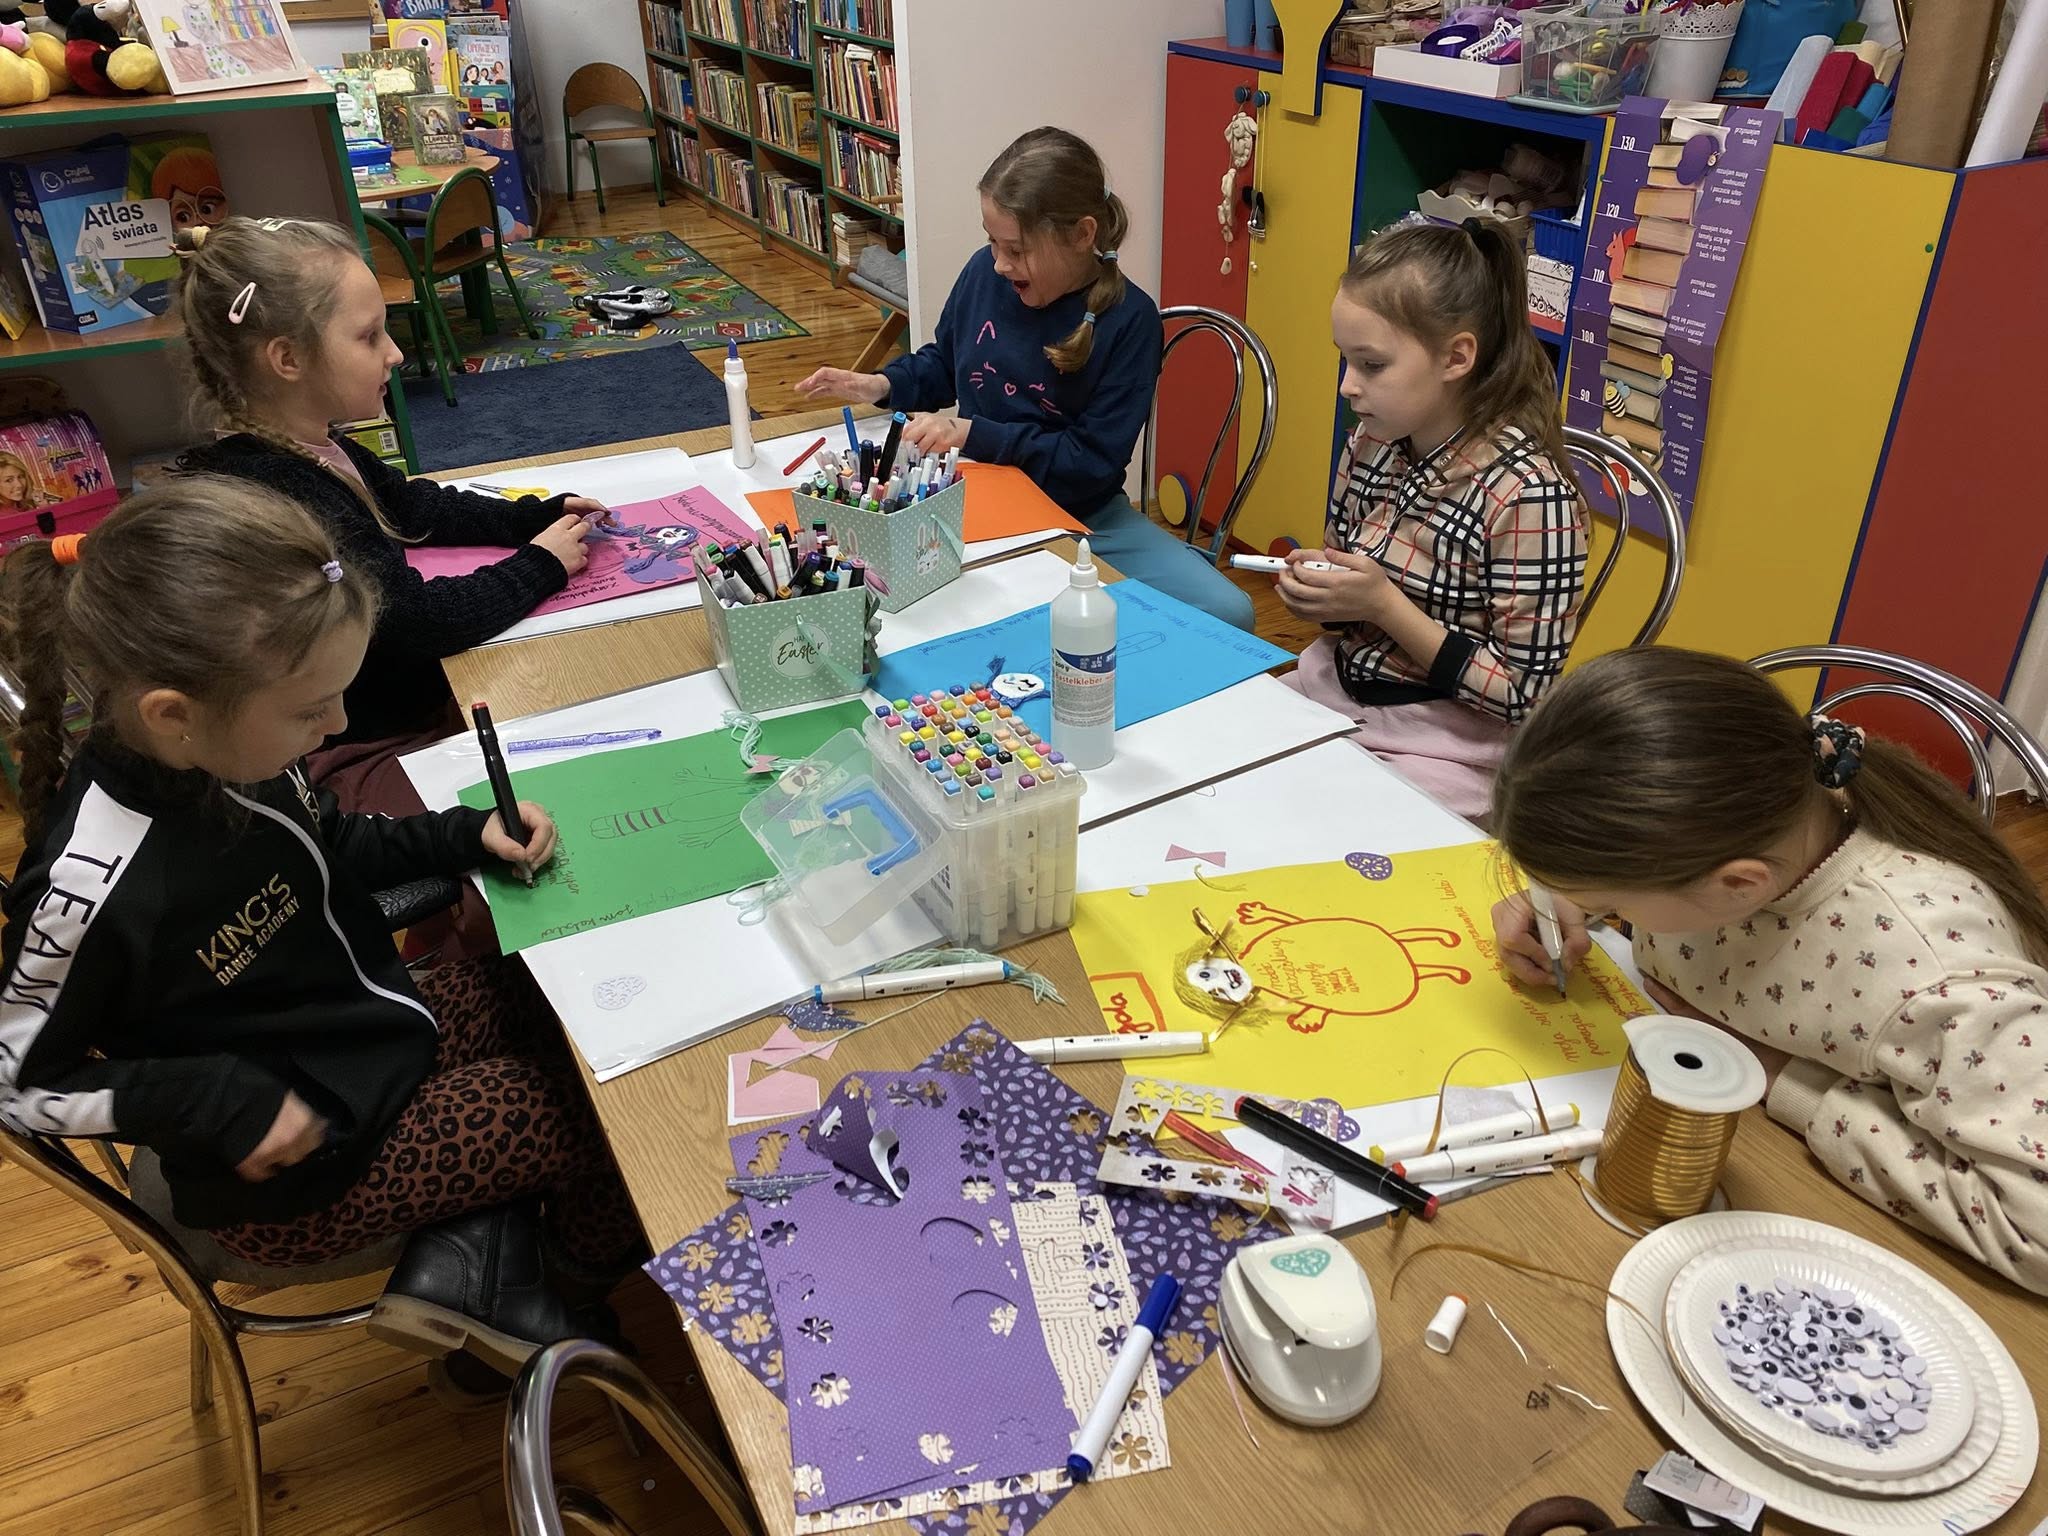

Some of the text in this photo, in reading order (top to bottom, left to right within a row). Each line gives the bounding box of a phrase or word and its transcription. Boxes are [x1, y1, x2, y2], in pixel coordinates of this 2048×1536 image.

[1620, 135, 1636, 150] 130
[84, 202, 144, 230] Atlas
[1606, 203, 1620, 218] 120
[112, 222, 158, 241] świata
[1592, 268, 1605, 283] 110
[1581, 329, 1595, 344] 100
[1580, 388, 1591, 402] 90
[777, 641, 824, 666] Easter
[195, 873, 291, 973] KING'S
[1, 854, 124, 1016] TEAM
[216, 895, 300, 986] DANCE ACADEMY
